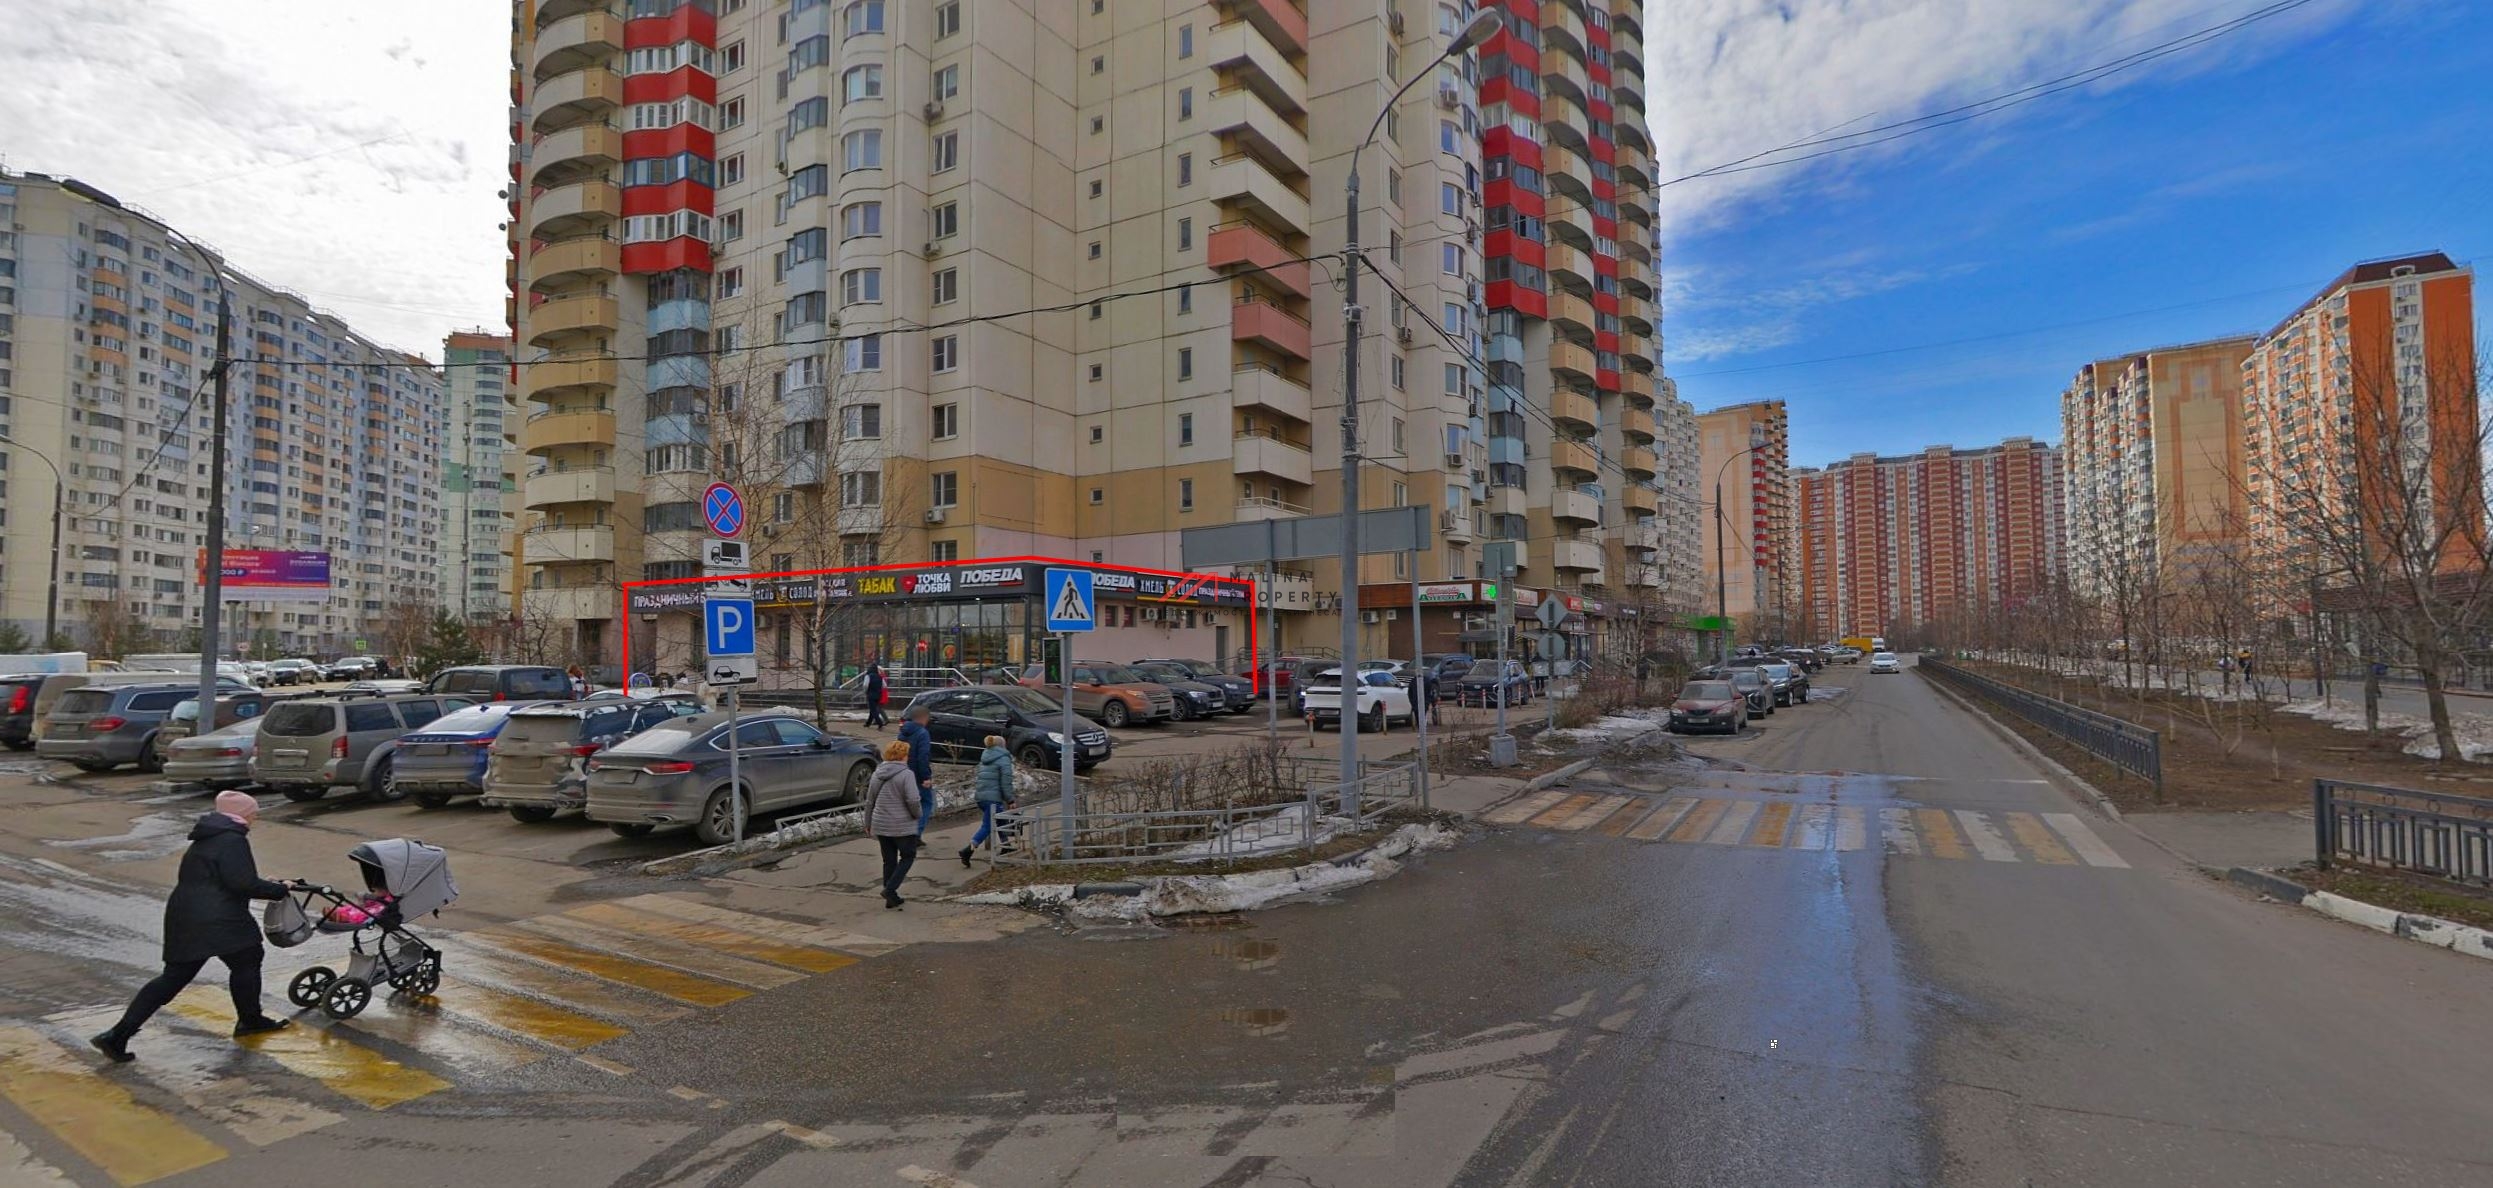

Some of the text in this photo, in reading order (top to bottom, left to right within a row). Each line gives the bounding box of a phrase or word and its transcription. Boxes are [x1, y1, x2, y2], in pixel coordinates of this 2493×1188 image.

[917, 572, 951, 584] ТОЧКА
[960, 567, 1023, 584] ПОБЕДА
[857, 577, 896, 594] ТАБАК
[913, 582, 951, 594] ЛЮБВИ
[1140, 579, 1164, 593] ХМЕЛЬ
[717, 606, 743, 649] P
